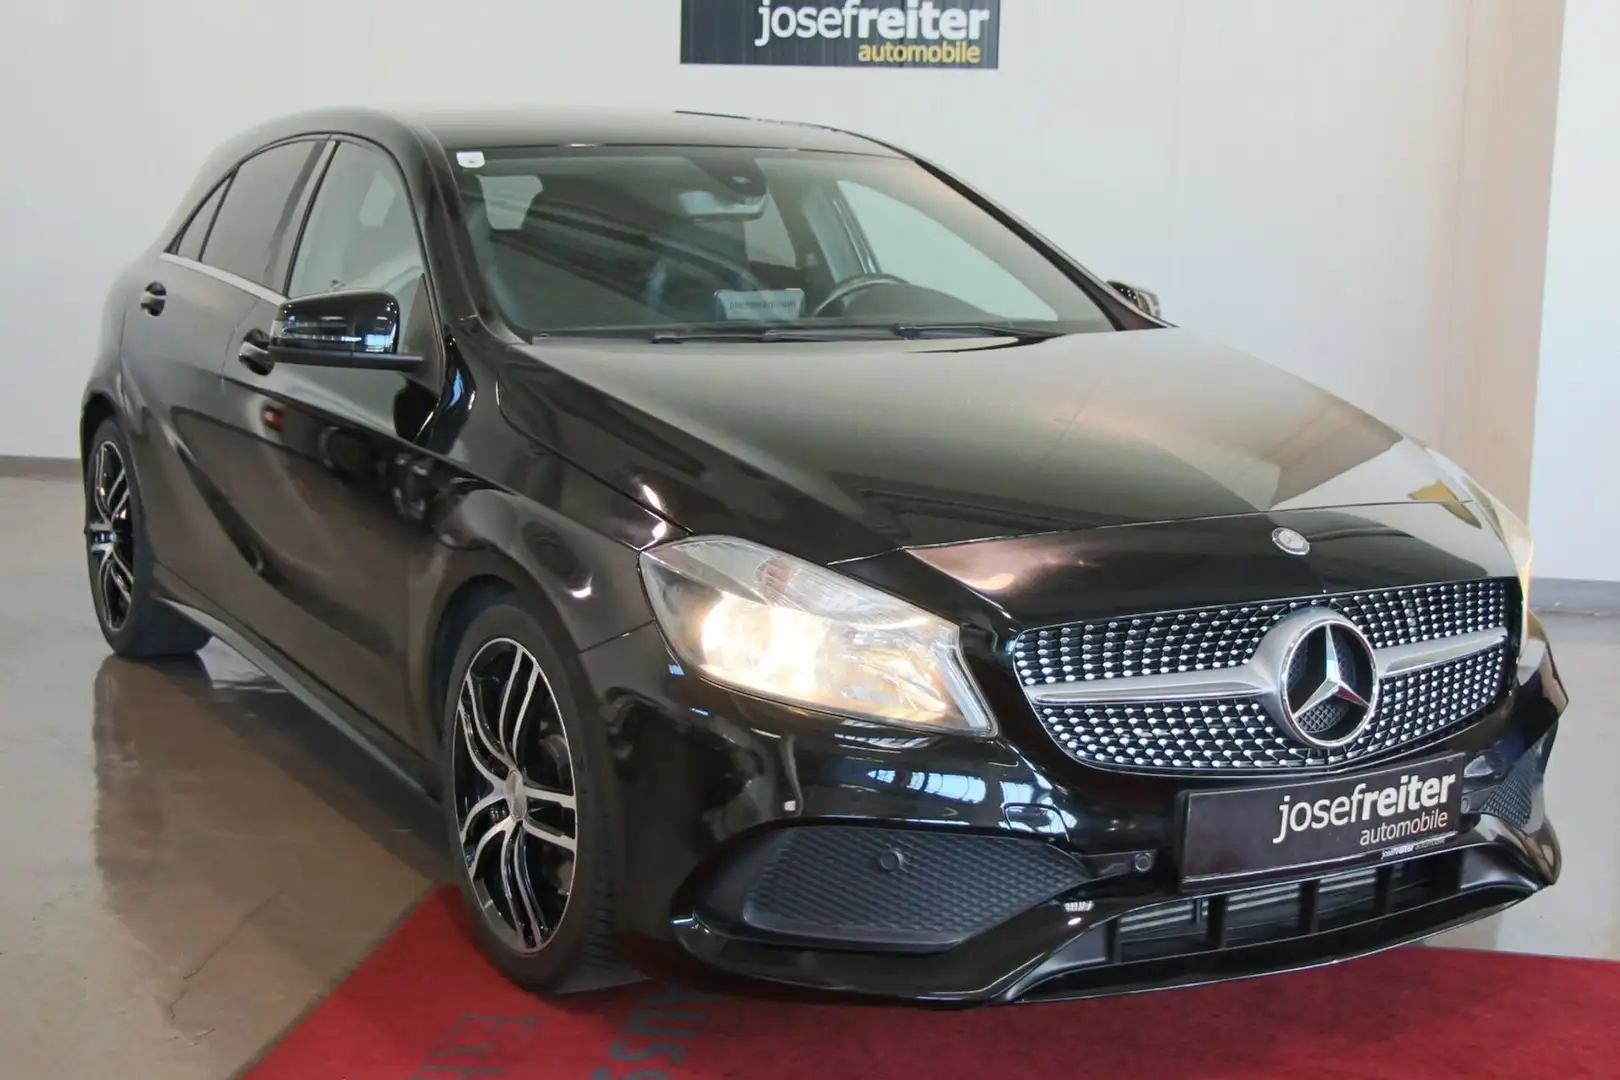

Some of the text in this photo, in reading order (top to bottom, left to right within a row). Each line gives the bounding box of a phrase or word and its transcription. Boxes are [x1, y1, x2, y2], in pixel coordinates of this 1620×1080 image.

[754, 0, 990, 47] josefreiter
[858, 40, 981, 64] automobile
[1272, 773, 1456, 844] josefreiter
[1359, 808, 1449, 847] automobile
